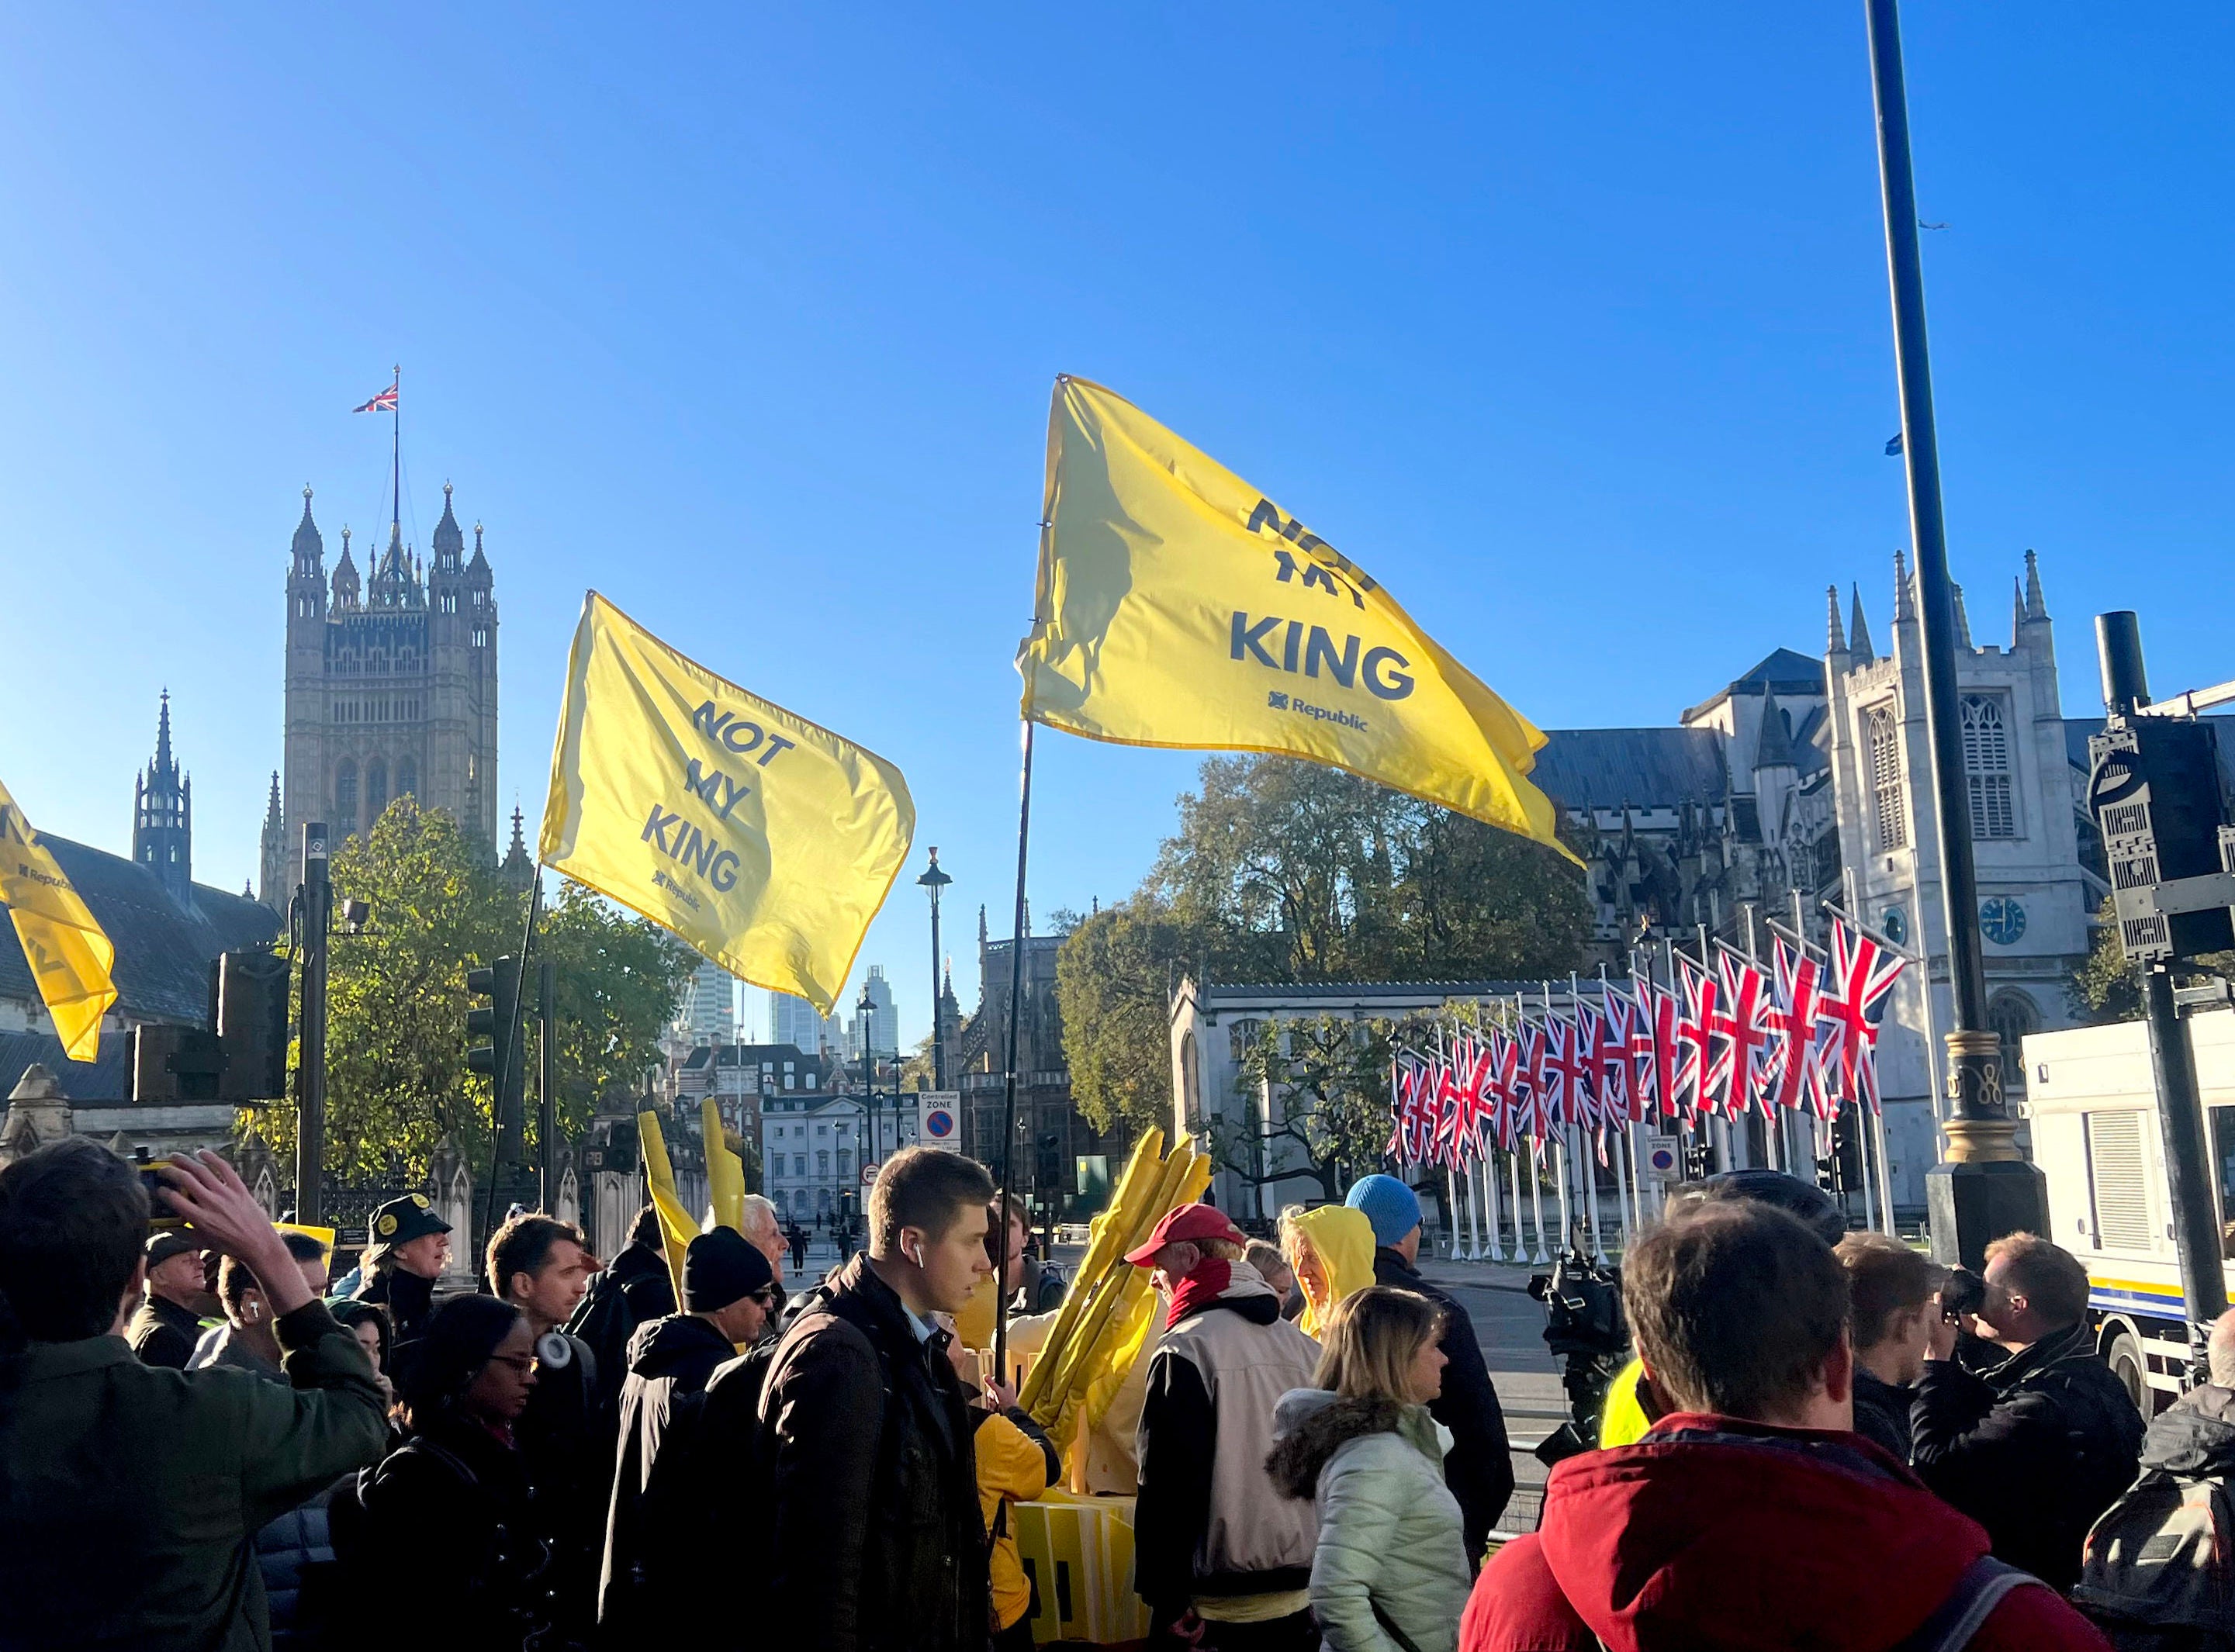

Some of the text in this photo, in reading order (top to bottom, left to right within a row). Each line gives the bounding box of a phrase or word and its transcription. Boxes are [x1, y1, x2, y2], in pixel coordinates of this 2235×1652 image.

[1230, 611, 1414, 700] KING
[693, 700, 796, 766] NOT
[1292, 699, 1368, 733] Republic
[683, 758, 751, 820] MY
[640, 804, 740, 893] KING
[30, 869, 74, 891] Repub
[666, 878, 701, 912] Republic
